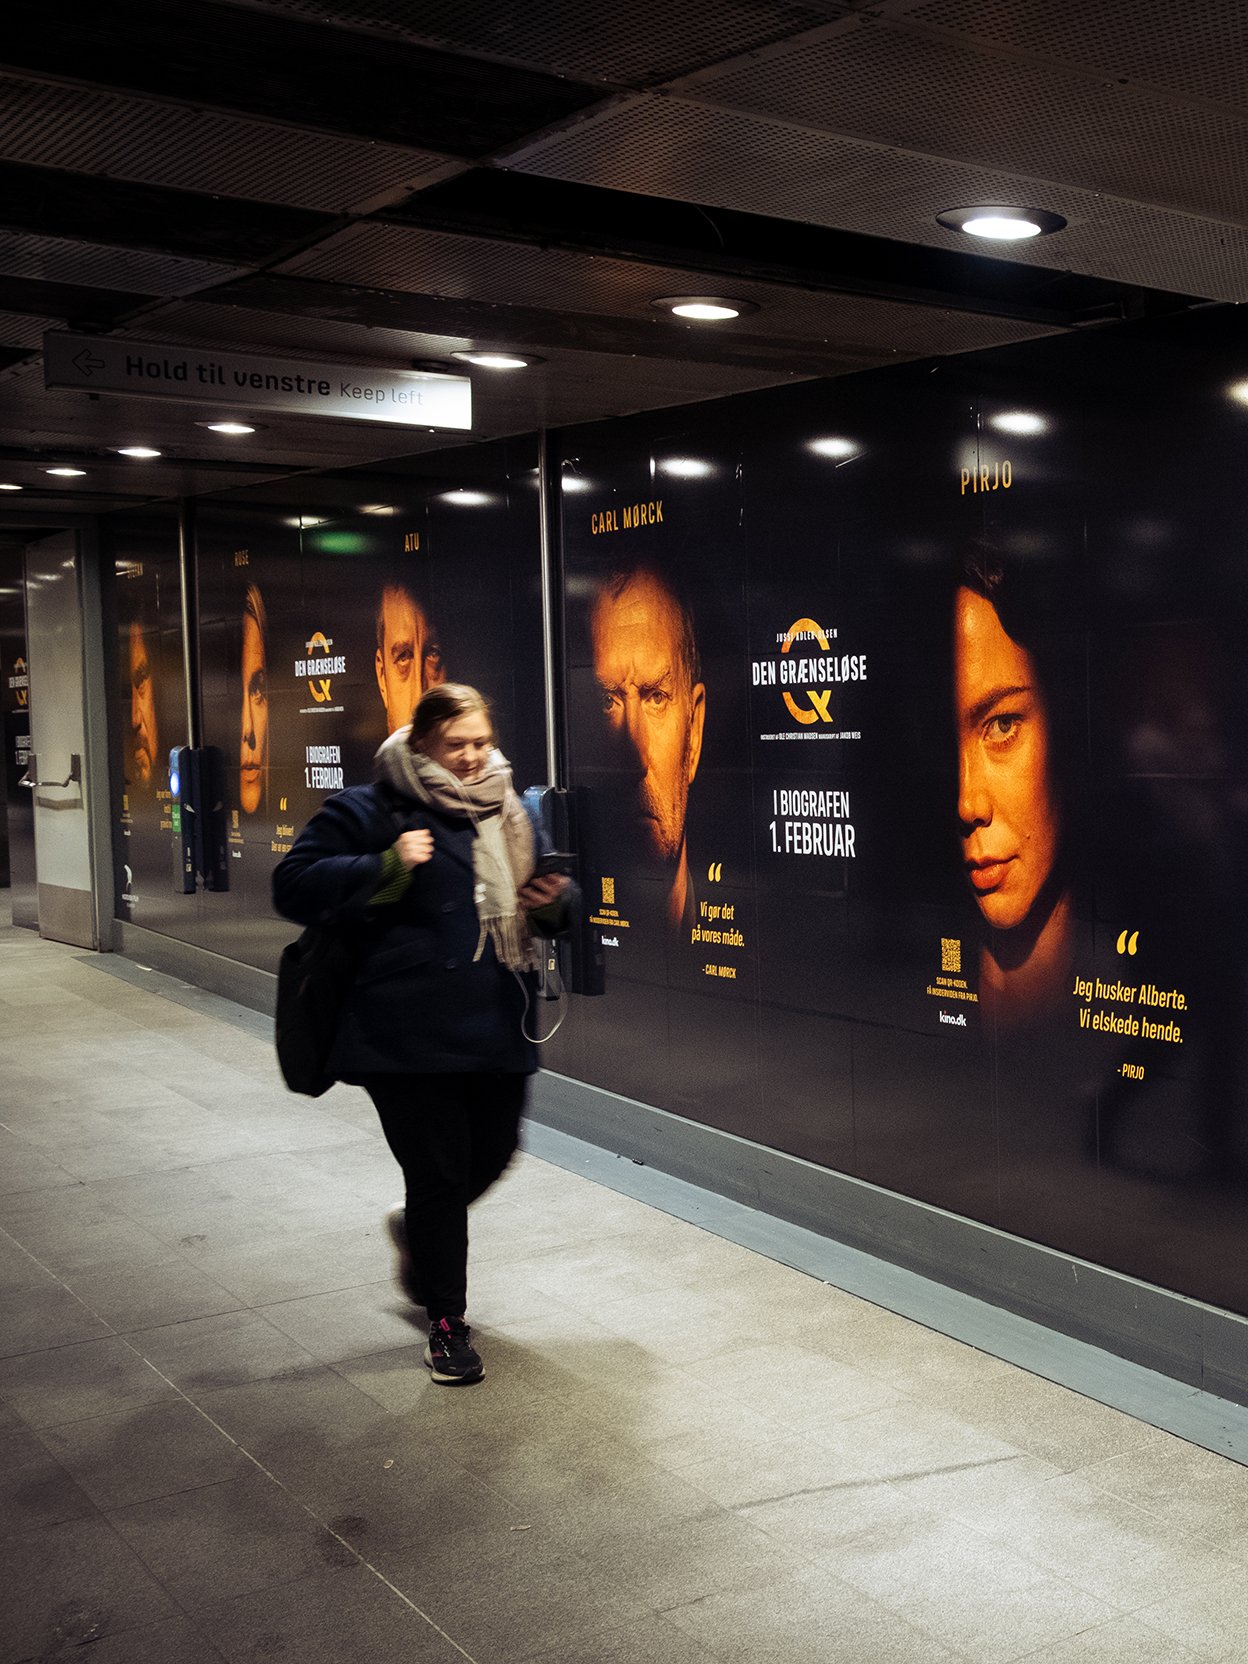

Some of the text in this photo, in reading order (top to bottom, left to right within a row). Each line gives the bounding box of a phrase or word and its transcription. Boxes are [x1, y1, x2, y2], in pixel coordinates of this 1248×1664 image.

[126, 355, 424, 406] Hold til venstre Keep left
[961, 459, 1012, 495] PIRJO
[591, 500, 664, 535] CARL MØRCK
[404, 531, 420, 552] ATU
[752, 654, 868, 686] DEN GRÆNSELØSE
[311, 767, 344, 790] FEBRUAR
[773, 789, 850, 818] I BIOGRAFEN
[769, 820, 856, 858] 1. FEBRUAR
[700, 901, 735, 922] Vi gør det
[691, 923, 745, 947] på vores måde.
[705, 963, 718, 977] CARL
[718, 965, 737, 979] MØRCK
[1072, 975, 1188, 1011] Jeg husker Alberte.
[939, 1009, 967, 1027] kino.dk
[1079, 1007, 1183, 1044] Vi elskede hende.
[1122, 1063, 1145, 1081] PIRJO
